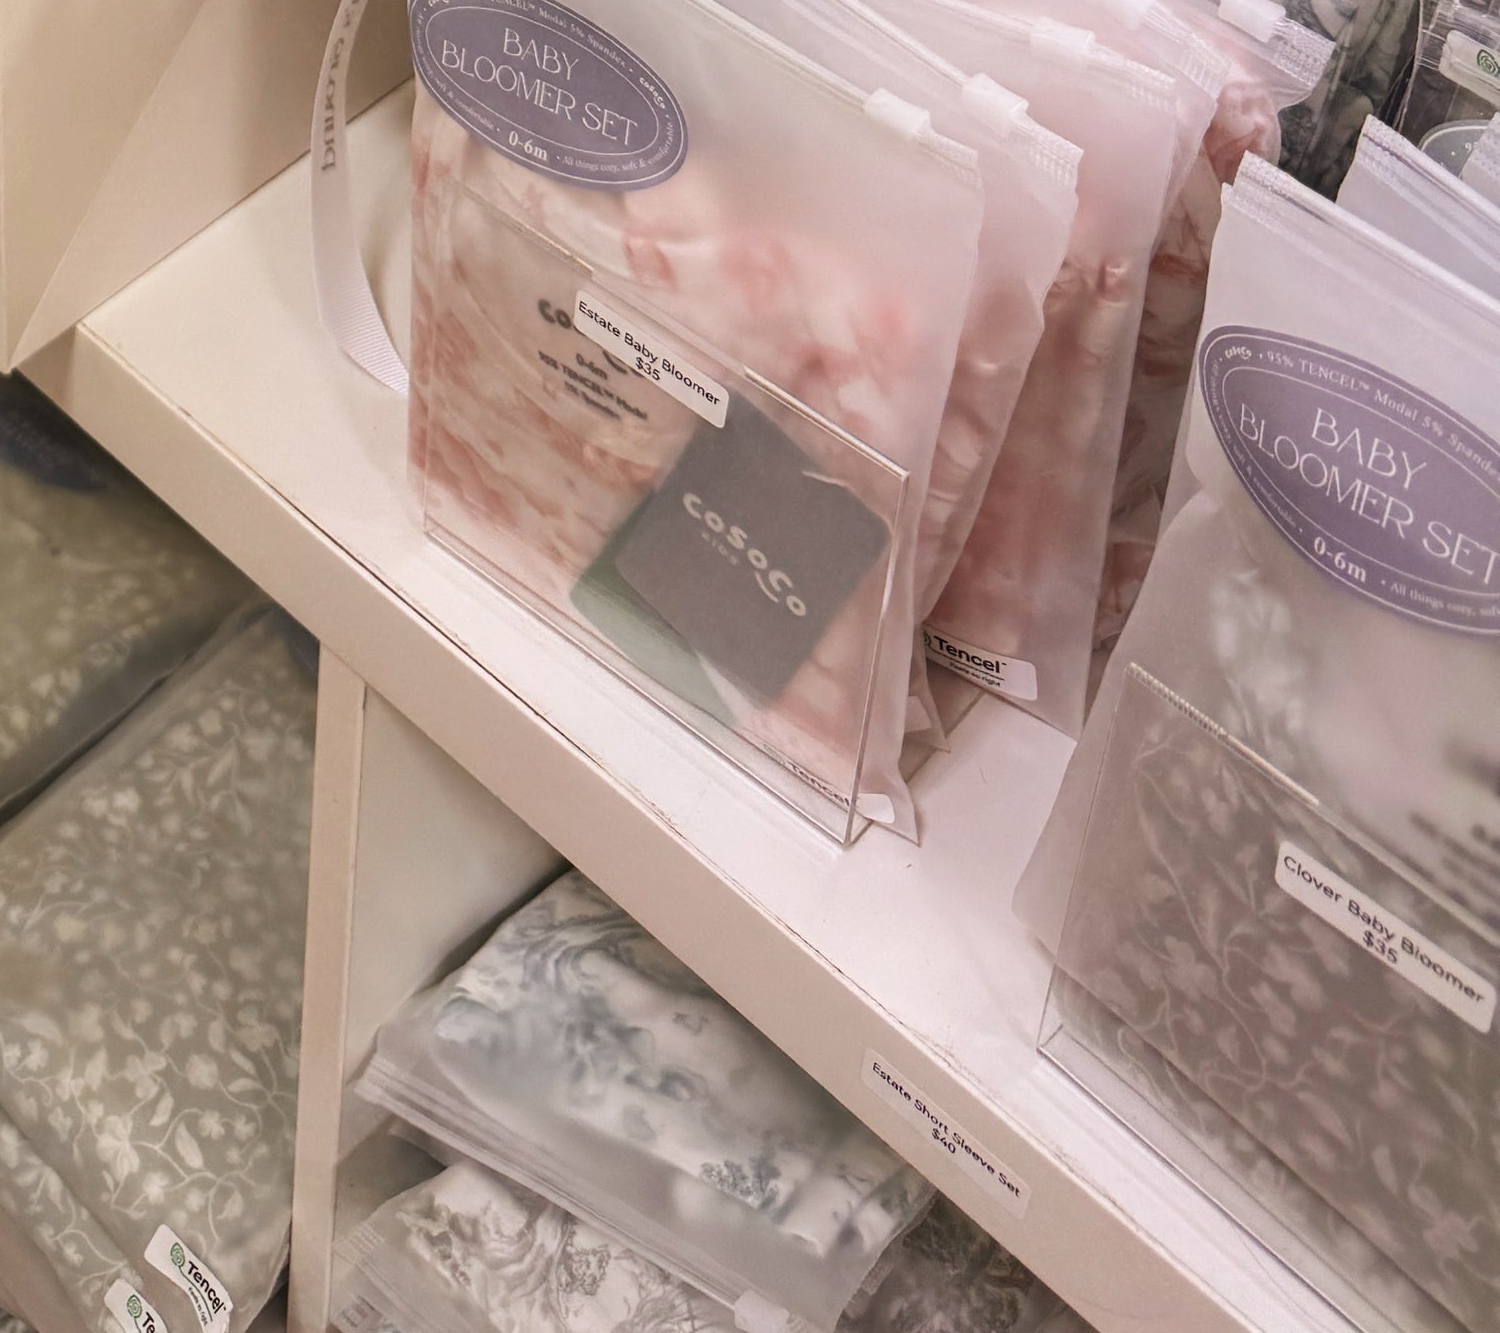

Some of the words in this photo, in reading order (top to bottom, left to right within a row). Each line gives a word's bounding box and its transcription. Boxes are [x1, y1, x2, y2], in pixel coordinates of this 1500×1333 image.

[503, 27, 580, 81] BABY
[538, 6, 569, 29] Modal
[570, 22, 586, 40] 5%
[586, 32, 627, 69] Spandex
[441, 39, 577, 121] BLOOMER
[582, 102, 638, 145] SET
[508, 130, 549, 162] 0-6m
[575, 158, 600, 173] things
[578, 300, 621, 337] Estate
[623, 332, 659, 364] Baby
[661, 358, 721, 406] Bloomer
[634, 356, 661, 382] $35
[1266, 349, 1294, 368] 95%
[1373, 388, 1419, 422] Modal
[1420, 414, 1444, 438] 5%
[1449, 432, 1500, 482] Spande
[1310, 407, 1428, 490] BABY
[1239, 403, 1415, 539] BLOOMER
[1421, 519, 1500, 585] SET
[1312, 536, 1368, 584] 0-6m
[1389, 580, 1408, 597] All
[1408, 588, 1446, 611] things
[1283, 855, 1343, 903] Clover
[1348, 898, 1395, 941] Baby
[1401, 935, 1485, 1004] Bloomer
[1362, 929, 1398, 965] $35
[872, 1062, 912, 1101] Estate
[914, 1098, 950, 1135] Short
[952, 1132, 995, 1175] Sleeve
[998, 1172, 1021, 1198] Set
[931, 1127, 957, 1155] $40
